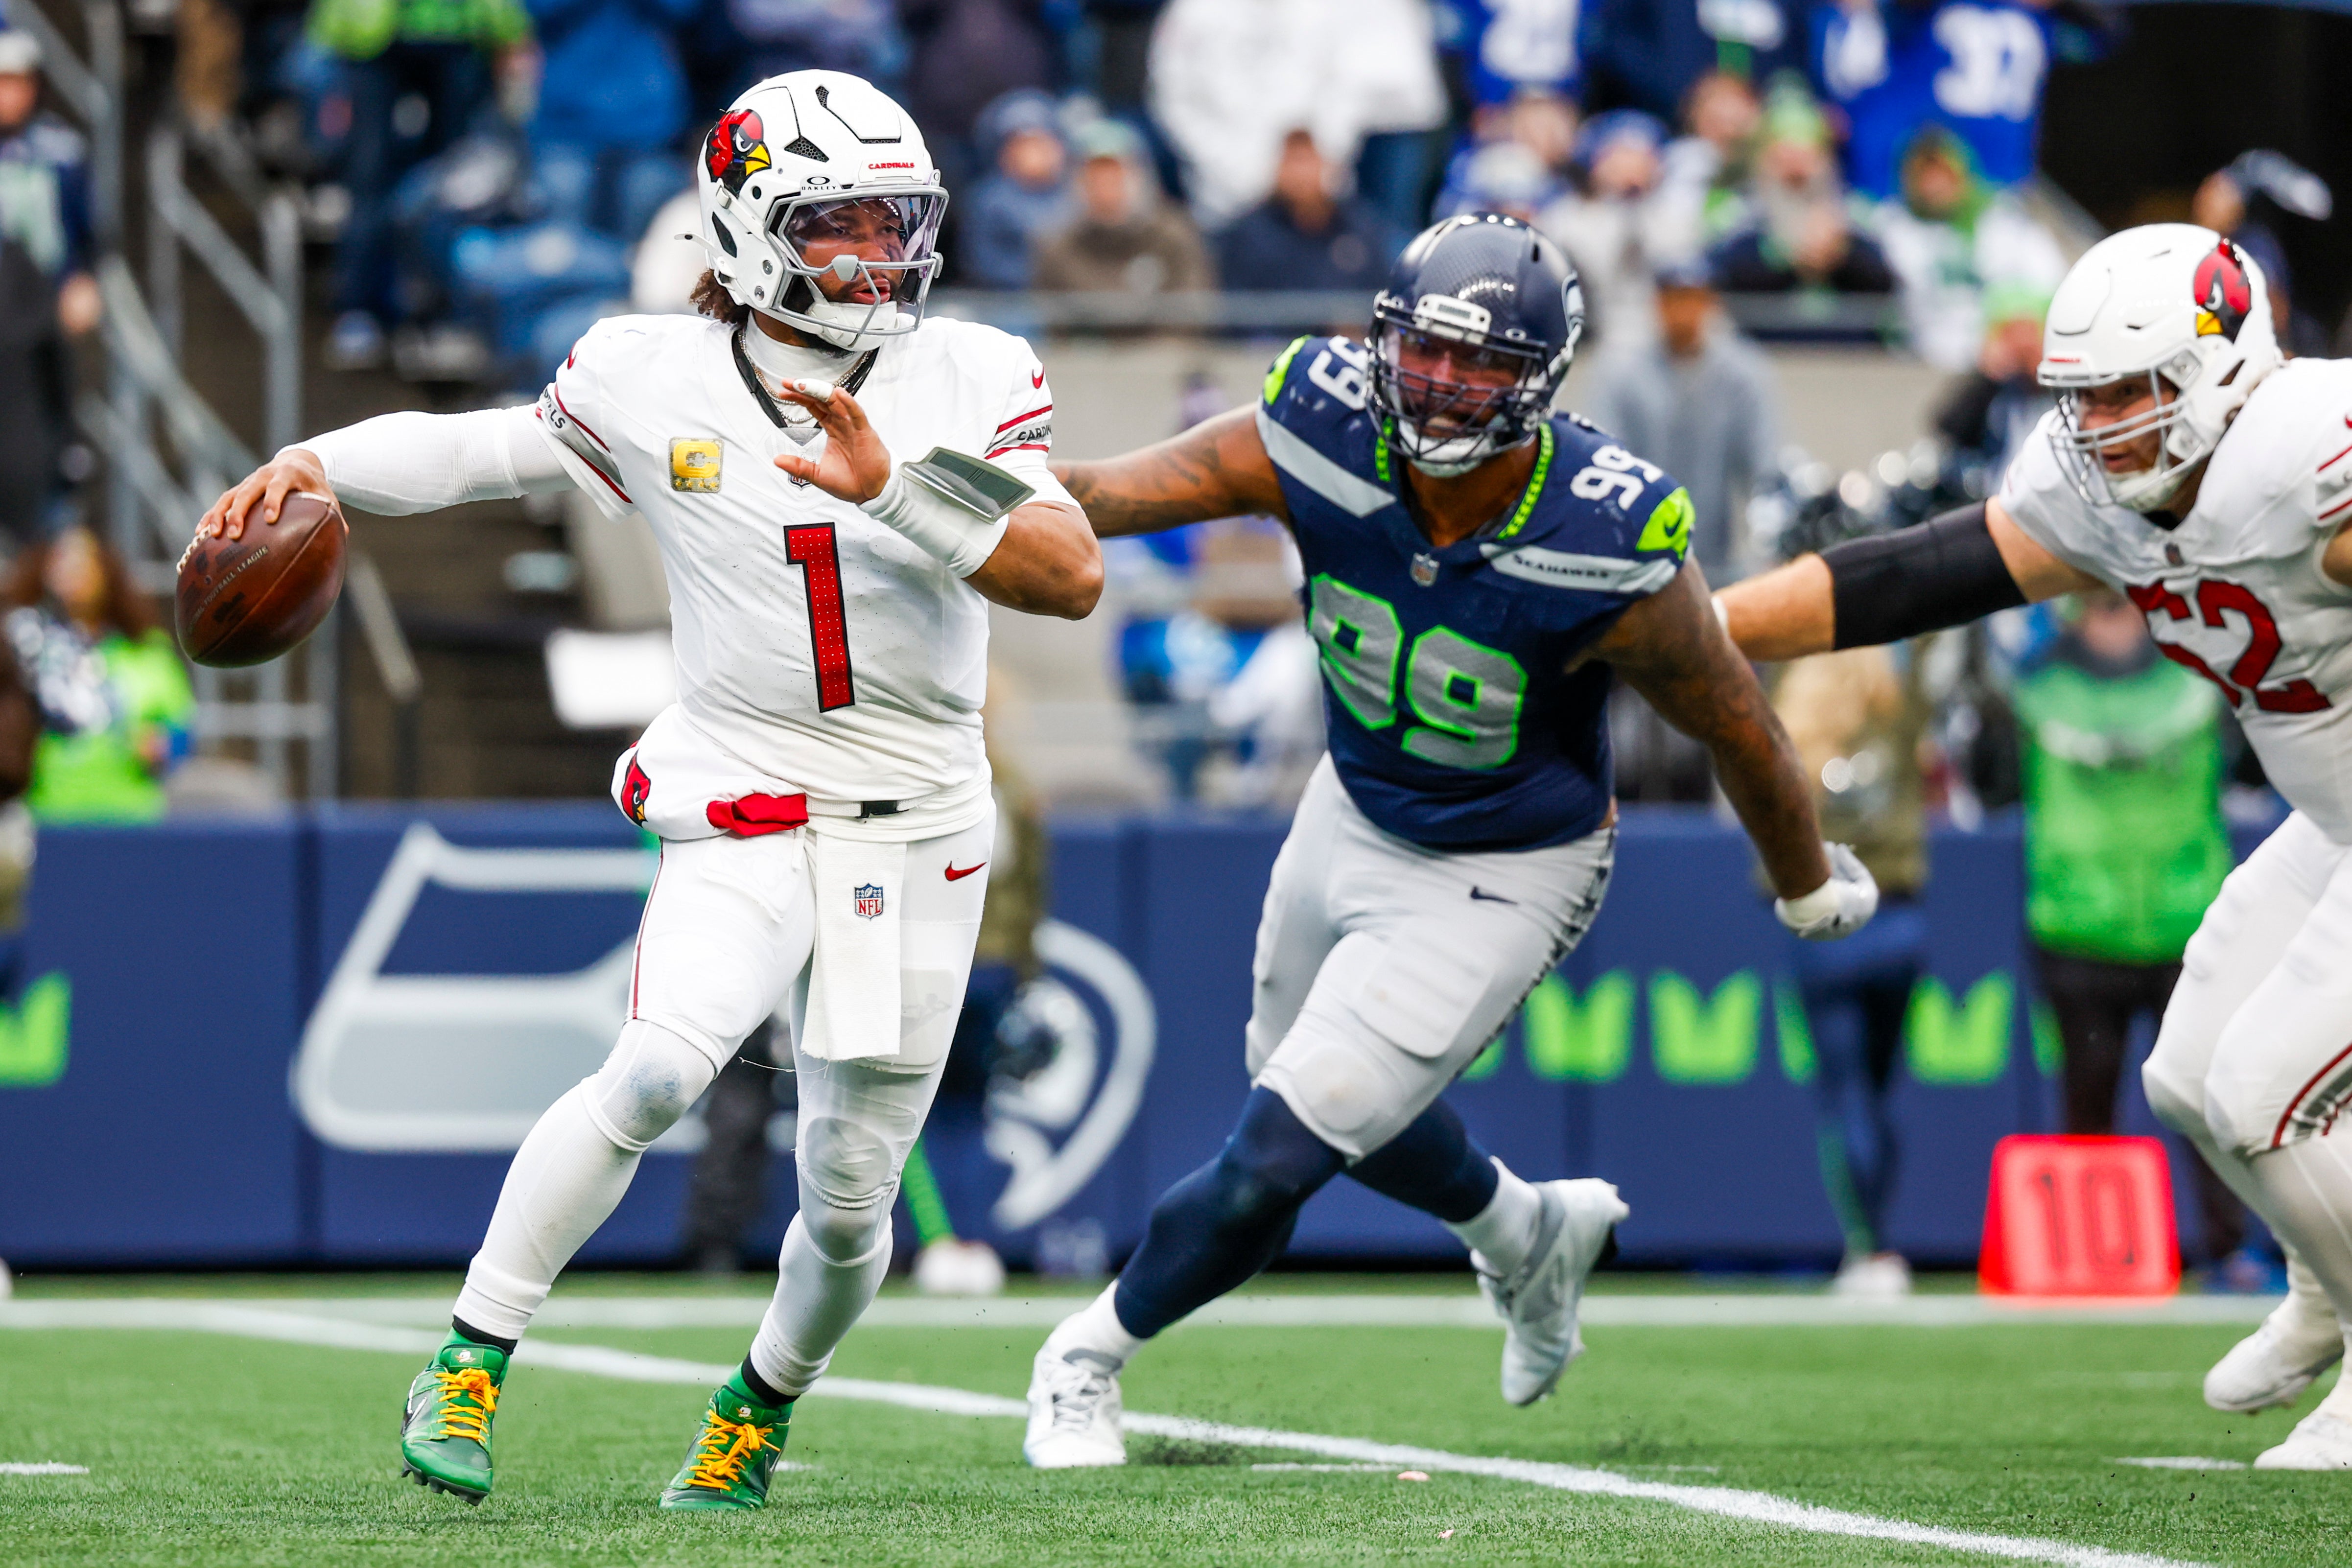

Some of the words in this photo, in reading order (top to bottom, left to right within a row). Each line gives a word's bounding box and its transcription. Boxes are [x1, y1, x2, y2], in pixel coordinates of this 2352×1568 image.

[237, 545, 269, 573] LEAGUE
[783, 522, 855, 713] 1
[1308, 572, 1529, 771] 99
[857, 899, 881, 916] NFL
[2028, 1168, 2136, 1267] 10
